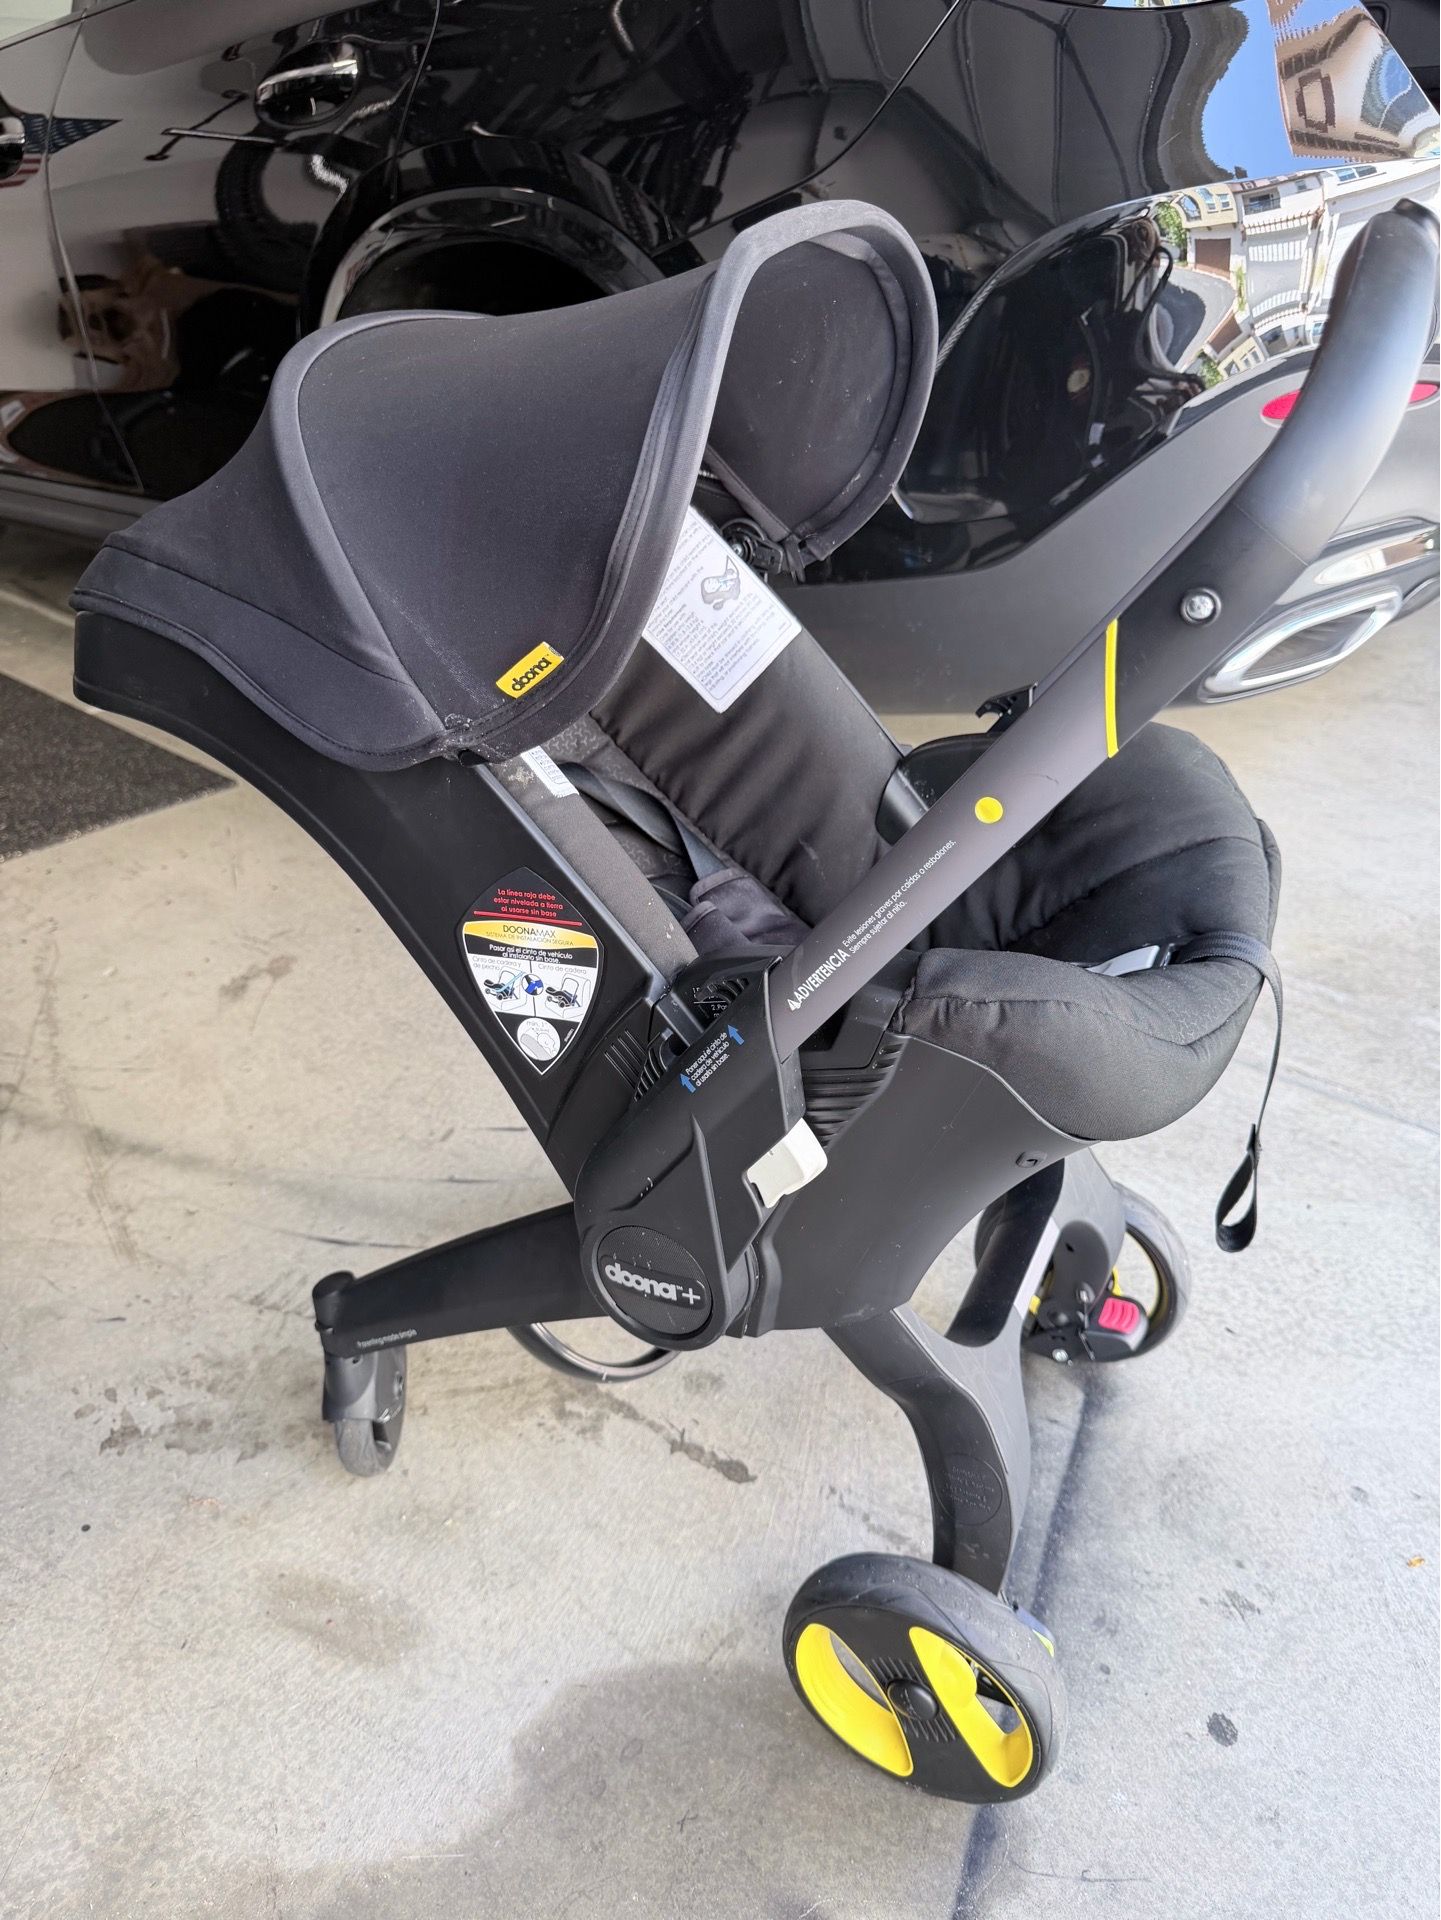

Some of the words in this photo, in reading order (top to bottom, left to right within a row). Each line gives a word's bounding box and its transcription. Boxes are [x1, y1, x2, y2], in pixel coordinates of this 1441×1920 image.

[512, 658, 552, 690] doona
[511, 898, 539, 907] nivelada
[547, 901, 563, 910] tierra
[538, 892, 555, 900] debe
[842, 932, 856, 947] Evite
[854, 915, 876, 936] lesiones
[875, 900, 894, 920] graves
[891, 890, 902, 905] por
[901, 872, 920, 892] caídas
[923, 840, 956, 871] resbalones.
[503, 925, 555, 938] DOONAMAX
[849, 933, 872, 954] Siempre
[870, 917, 888, 936] sujetar
[887, 911, 894, 919] al
[490, 944, 505, 952] Pasar
[522, 948, 537, 956] cinto
[548, 950, 573, 959] vehículo
[793, 948, 850, 1006] ADVERTENCIA
[685, 1062, 698, 1075] Poner
[698, 1050, 707, 1063] aquí
[706, 1047, 711, 1055] el
[710, 1039, 721, 1050] cinto
[691, 1064, 707, 1080] cadera
[711, 1041, 729, 1059] vehículo
[700, 1069, 713, 1082] usarlo
[716, 1054, 730, 1065] base.
